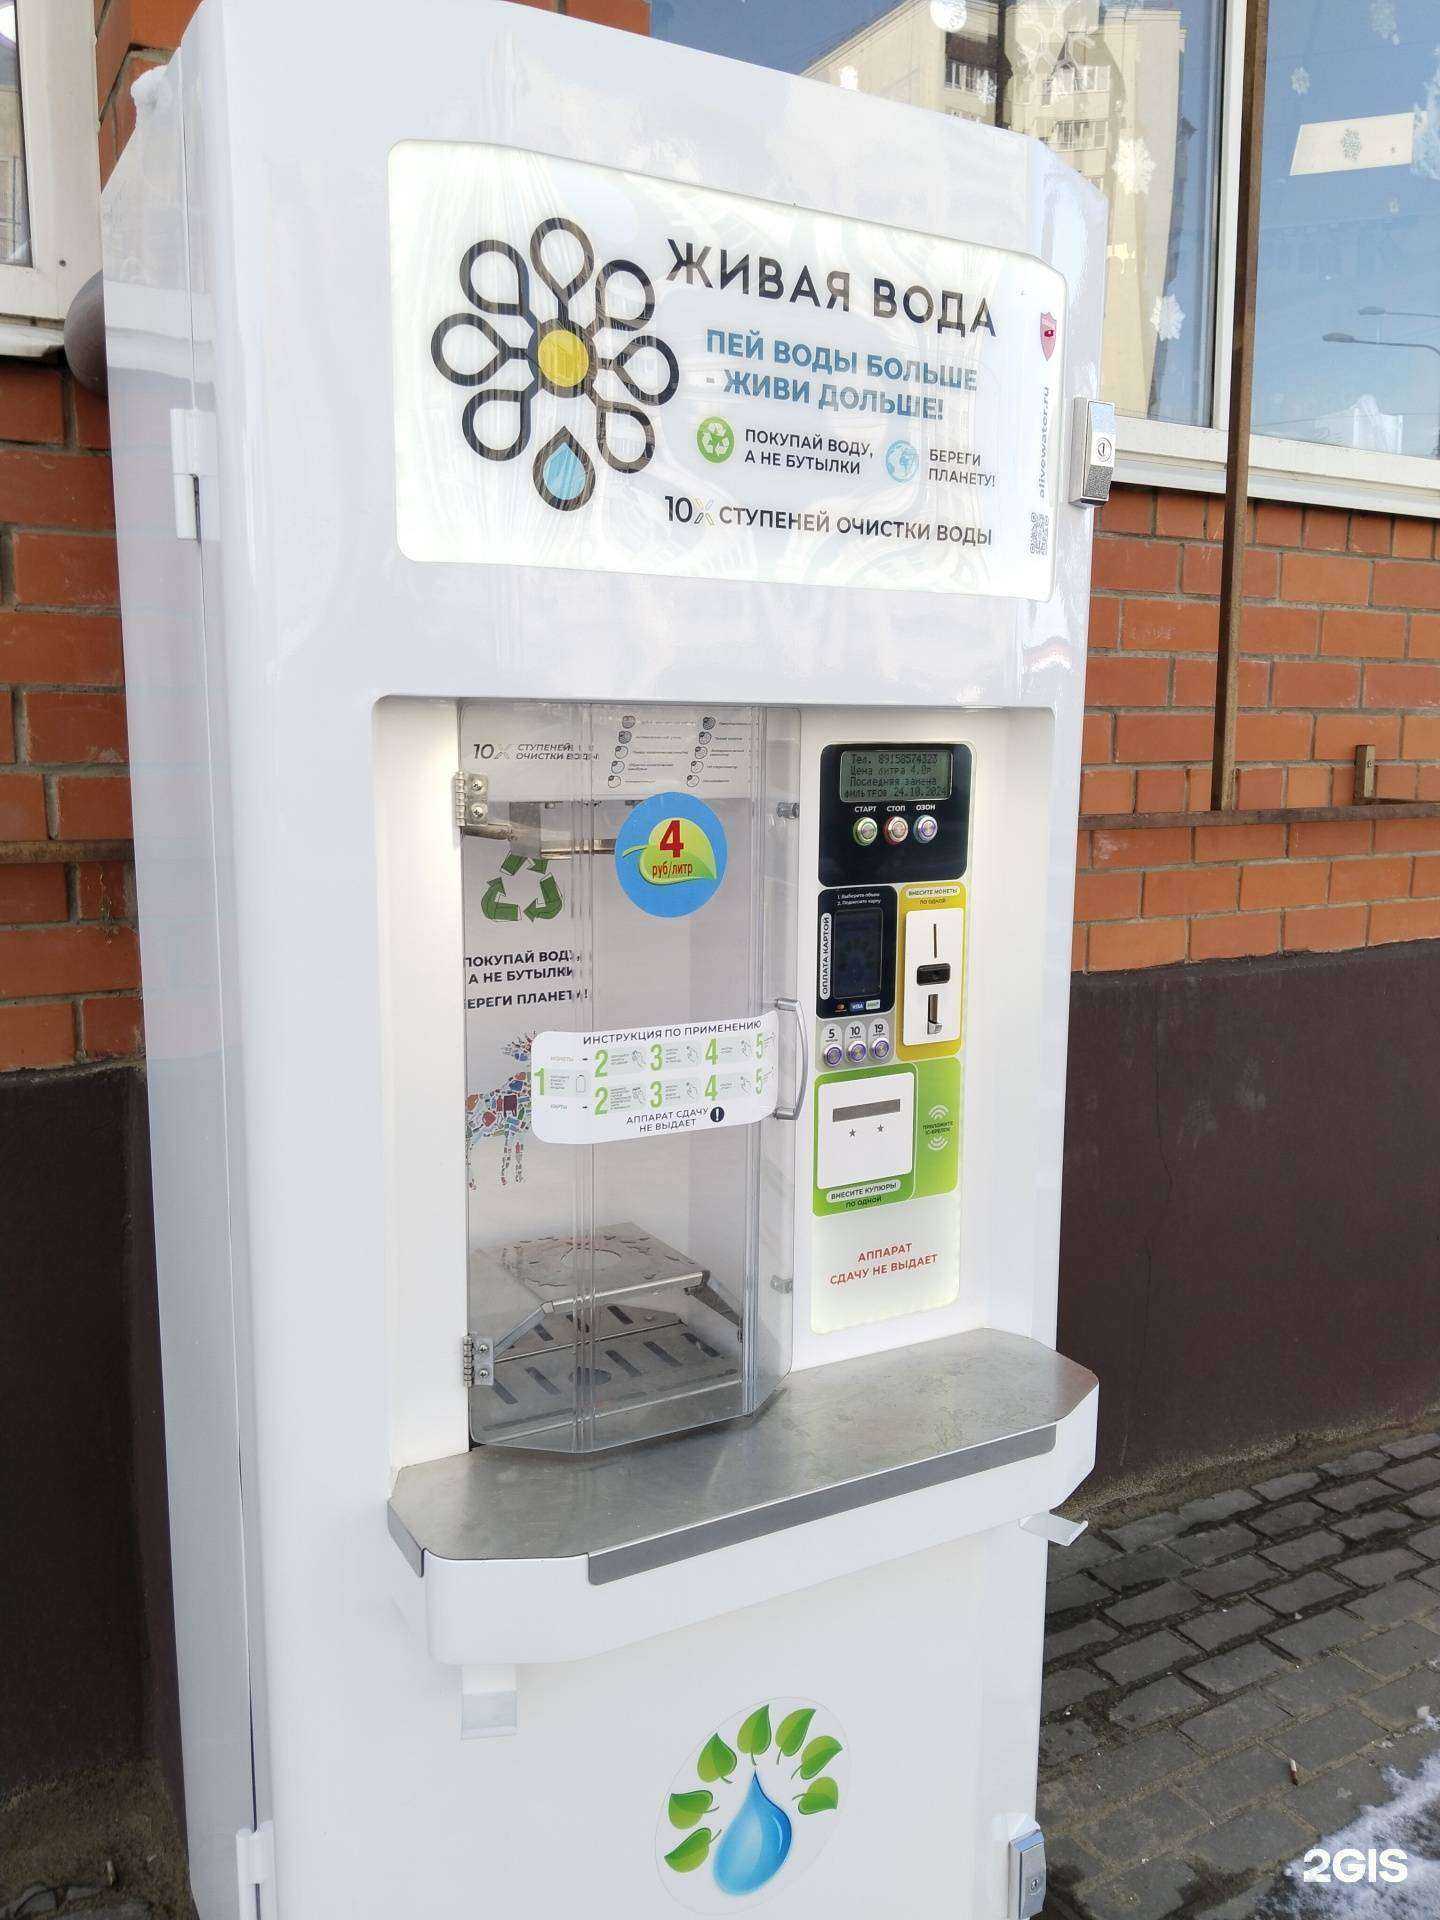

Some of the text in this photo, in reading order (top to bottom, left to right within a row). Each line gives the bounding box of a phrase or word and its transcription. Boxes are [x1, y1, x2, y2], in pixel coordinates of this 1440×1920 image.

[666, 238, 996, 338] ЖИВАЯ ВОДА
[706, 328, 978, 391] ПЕЙ ВОДЫ БОЛЬШЕ
[723, 369, 810, 404] ЖИВИ
[818, 383, 944, 420] ДОЛЬШЕ!
[745, 428, 874, 458] ПОКУПАЙ ВОДУ,
[744, 450, 861, 475] А НЕ БУТЫЛКИ
[929, 449, 981, 467] БЕРЕГИ
[928, 468, 996, 487] ПЛАНЕТУ!
[719, 505, 830, 533] СТУПЕНЕЙ
[836, 516, 930, 541] ОЧИСТКИ
[936, 524, 992, 547] ВОДЫ
[516, 752, 563, 760] ОЧИСТКИ
[517, 743, 574, 751] СТУПЕНЕЙ
[660, 820, 684, 858] 4
[652, 862, 693, 880] руб/литр
[468, 974, 478, 984] А
[483, 972, 502, 983] НЕ
[464, 995, 512, 1009] ЕРЕГИ
[583, 1020, 762, 1045] ИНСТРУКЦИЯ ПО ПРИМЕНЕНИЮ
[828, 1028, 835, 1039] 5
[850, 1026, 860, 1036] 10
[874, 1024, 884, 1033] 19
[650, 1044, 663, 1071] 3
[705, 1038, 718, 1065] 4
[755, 1033, 764, 1059] 5
[594, 1049, 608, 1078] 2
[534, 1067, 545, 1095] 1
[704, 1074, 718, 1101] 4
[594, 1086, 608, 1115] 2
[650, 1081, 663, 1108] 3
[626, 1107, 709, 1125] АППАРАТ СДАЧУ
[639, 1119, 696, 1132] НЕ ВЫДАЕТ
[830, 1183, 897, 1200] ВНЕСИТЕ КУПЮРЫ
[857, 1196, 882, 1206] ОДНОЙ
[858, 1243, 912, 1262] АППАРАТ
[830, 1254, 938, 1285] СДАЧУ НЕ ВЫДАЕТ
